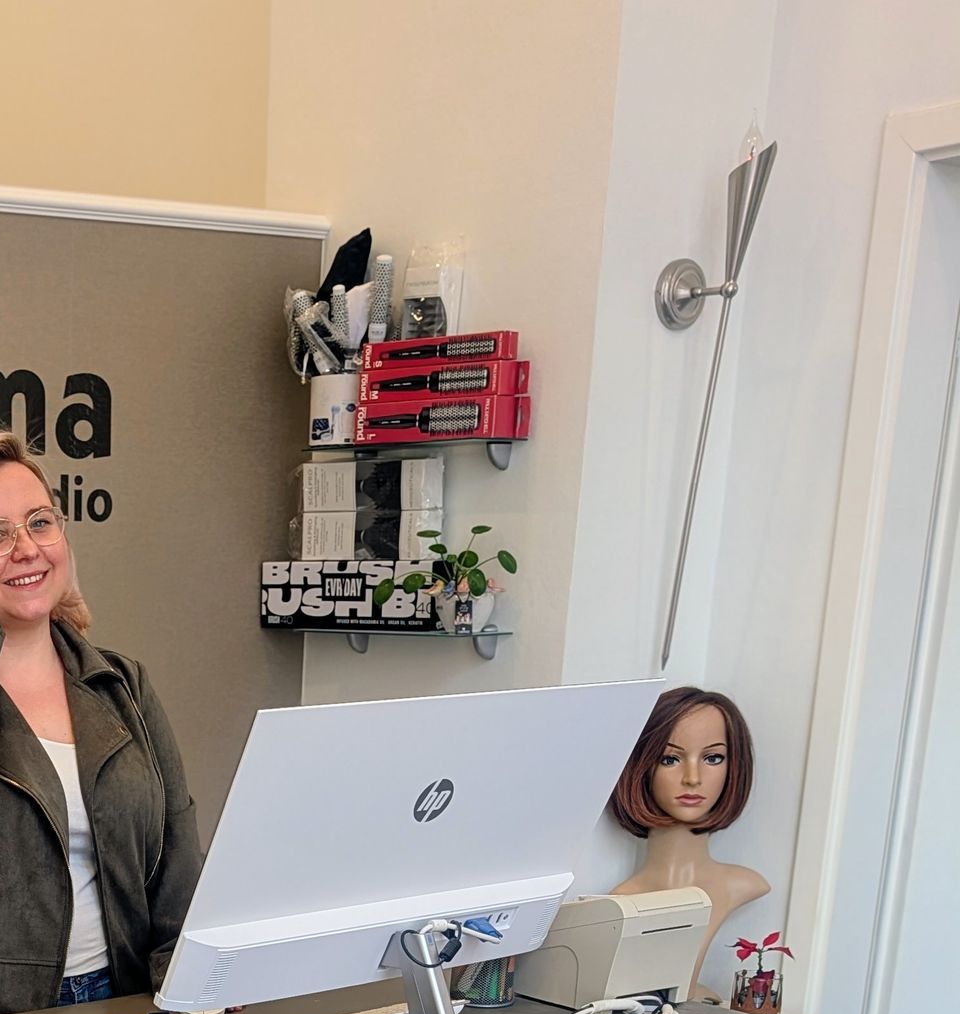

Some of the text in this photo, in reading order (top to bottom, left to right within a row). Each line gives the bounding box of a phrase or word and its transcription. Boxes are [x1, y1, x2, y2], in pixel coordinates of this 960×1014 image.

[360, 373, 369, 401] round
[371, 390, 379, 400] M
[356, 406, 367, 441] round
[262, 560, 433, 586] BRUSH
[262, 587, 373, 618] USH
[415, 778, 453, 823] hp
